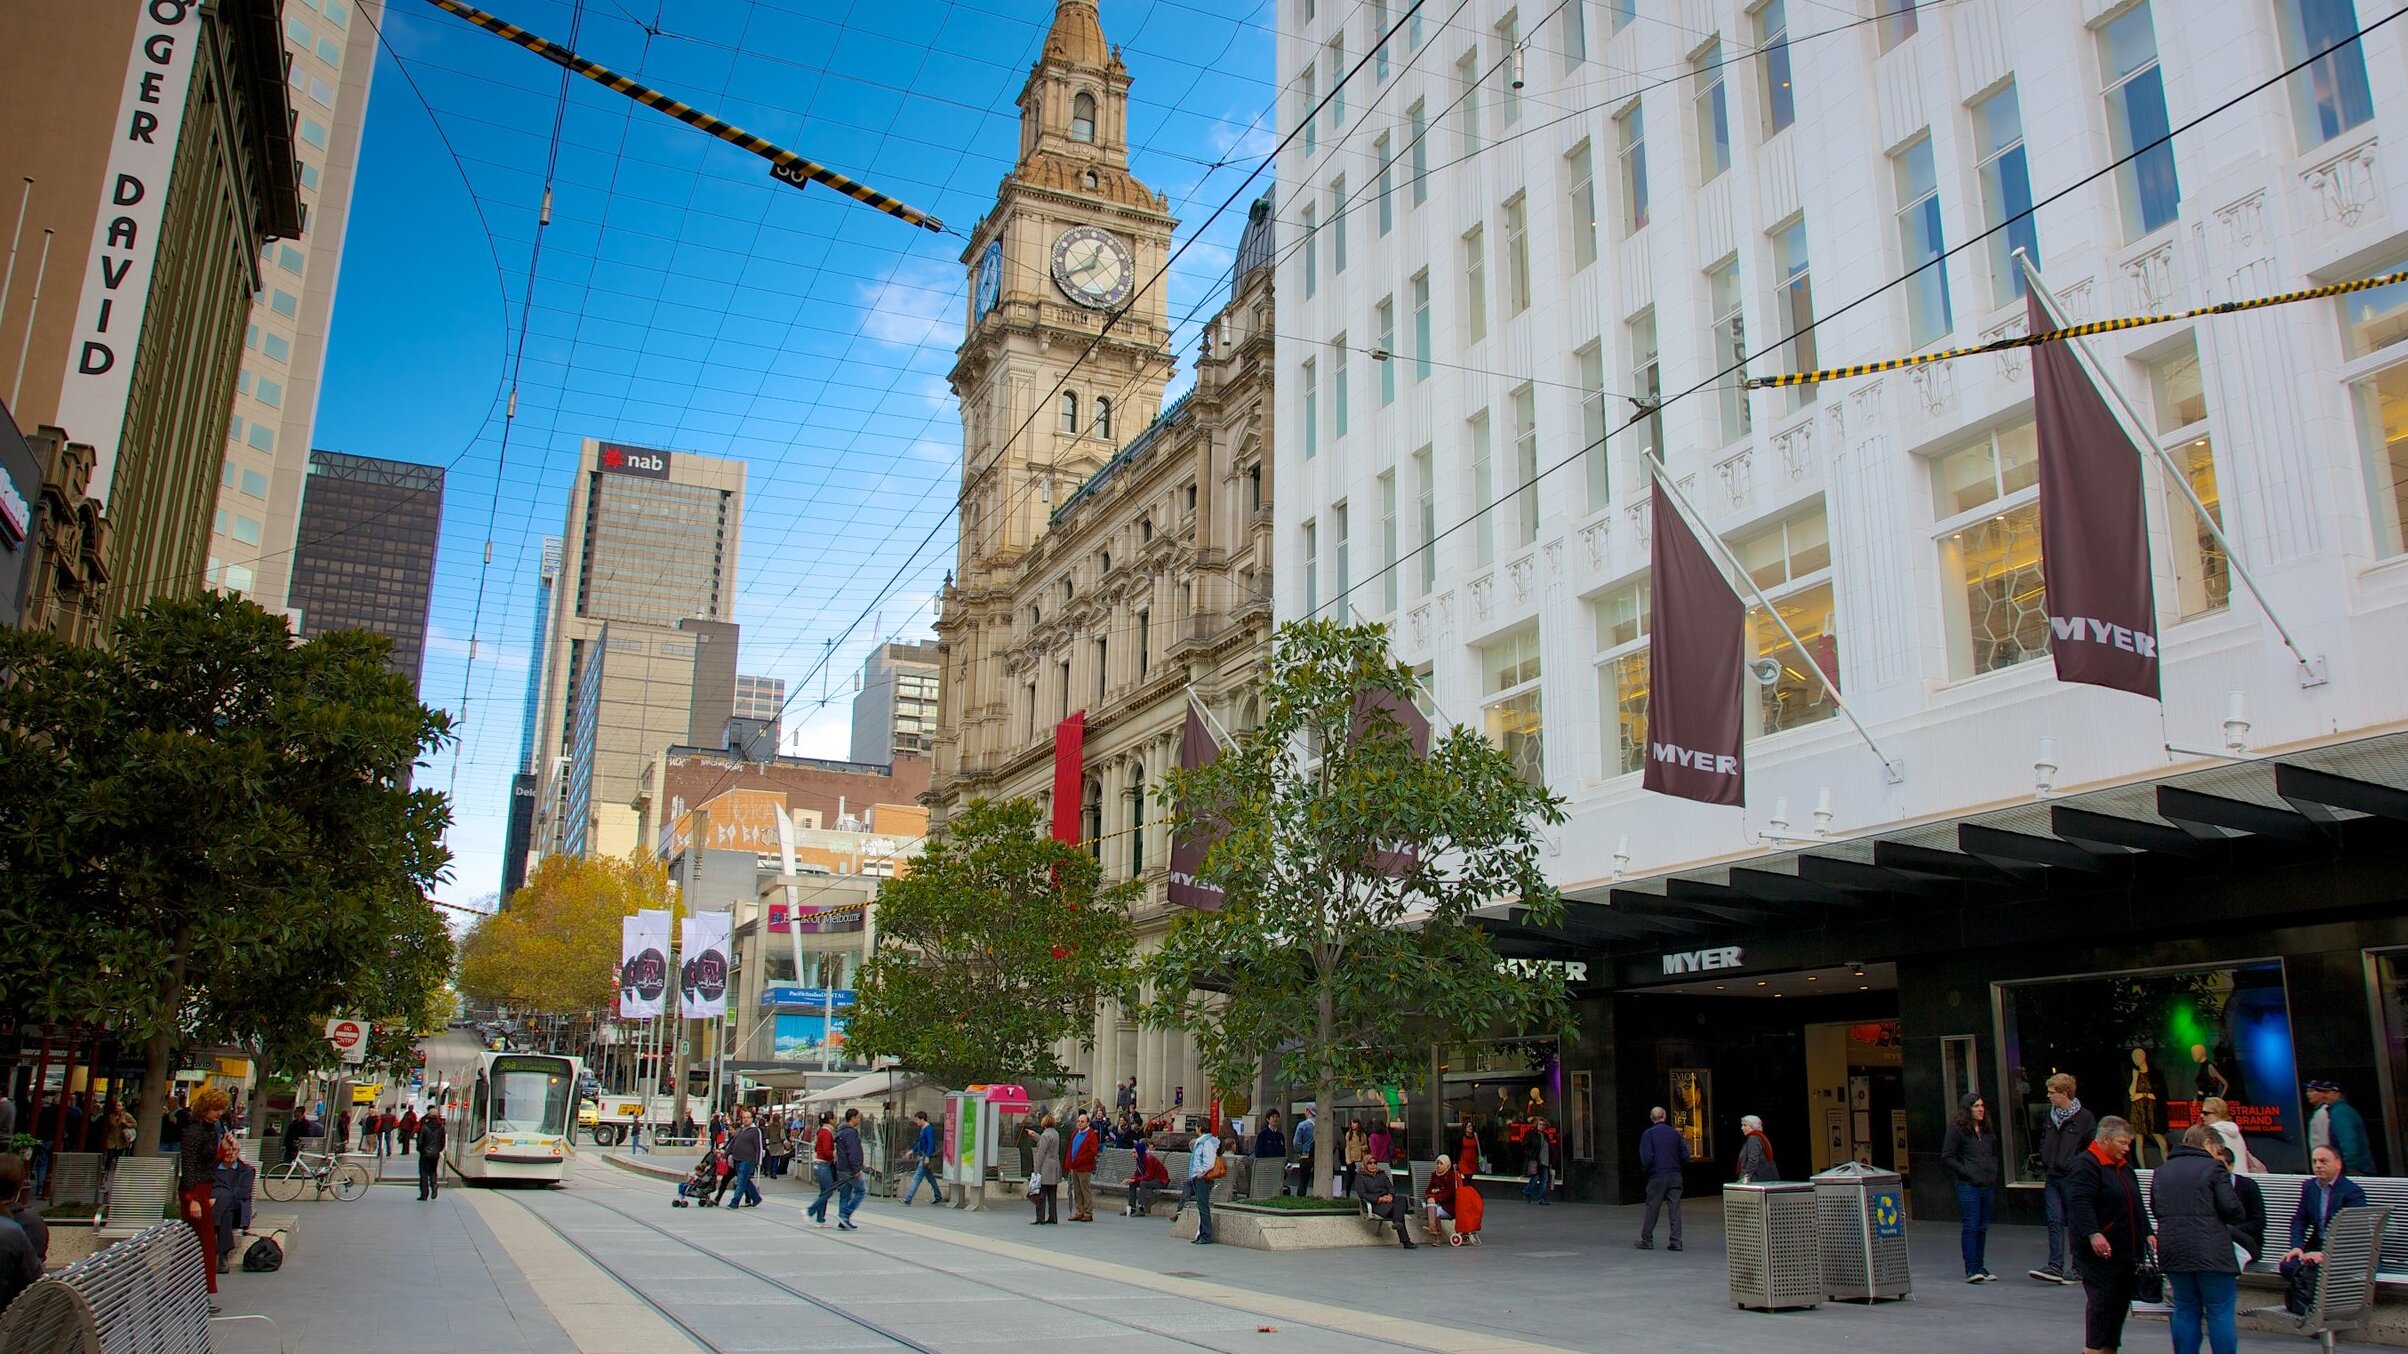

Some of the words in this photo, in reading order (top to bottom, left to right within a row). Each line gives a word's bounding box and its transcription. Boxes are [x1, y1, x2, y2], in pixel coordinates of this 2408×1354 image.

[129, 0, 196, 144] OGER
[78, 173, 145, 375] DAVID
[627, 455, 663, 471] nab
[2050, 616, 2157, 658] MYER
[1653, 742, 1737, 775] MYER
[823, 912, 860, 924] Melbourne
[1662, 946, 1743, 975] MYER
[2230, 1106, 2280, 1116] STRALIAN
[2236, 1116, 2272, 1125] BRAND
